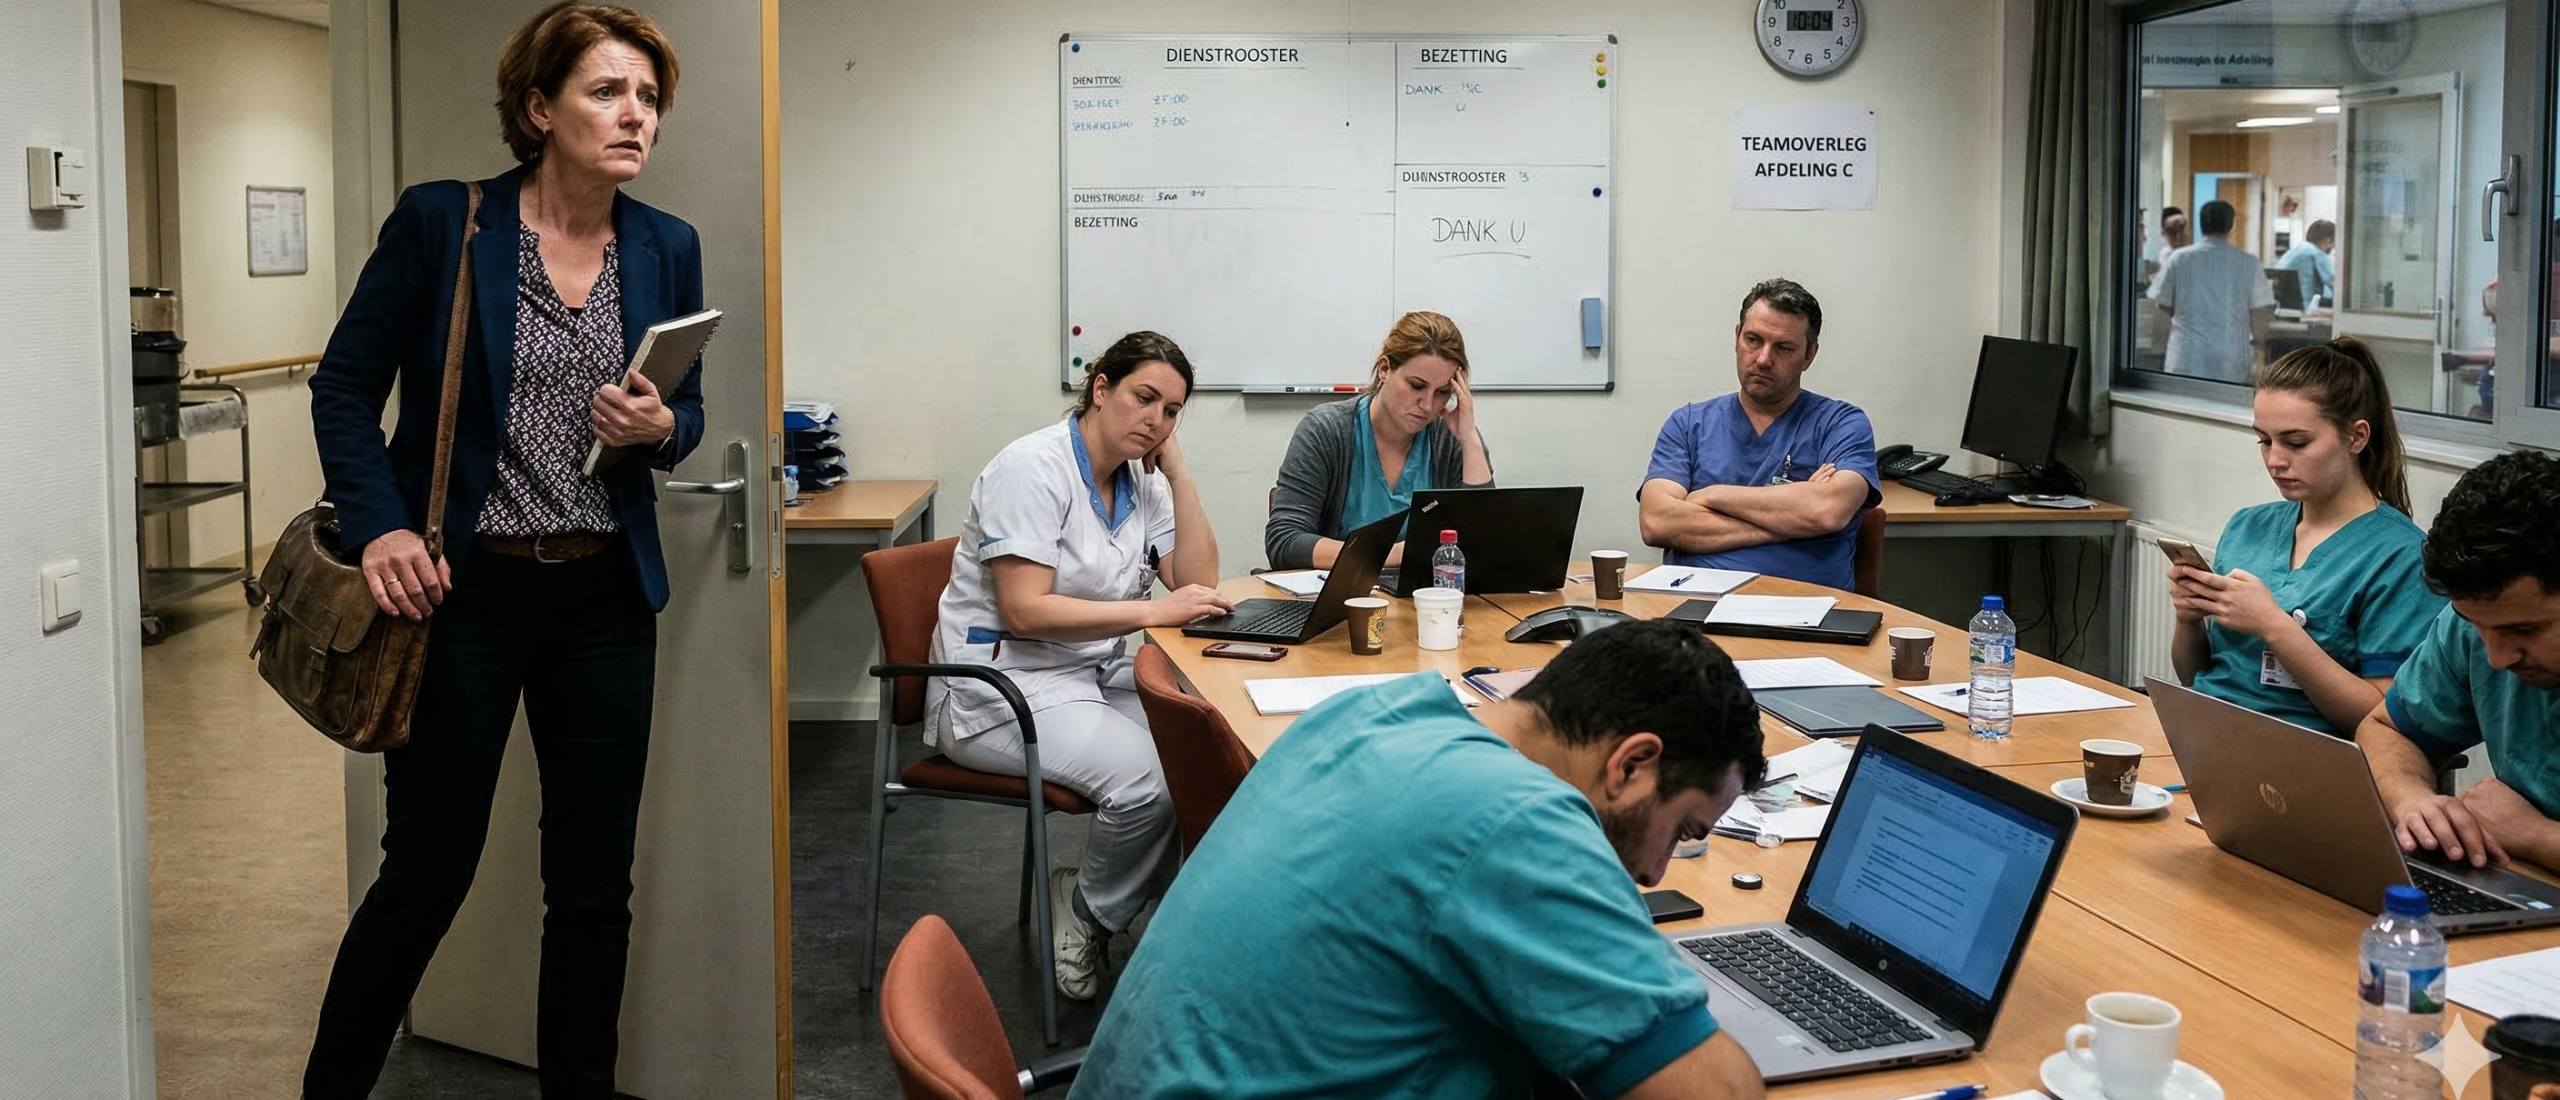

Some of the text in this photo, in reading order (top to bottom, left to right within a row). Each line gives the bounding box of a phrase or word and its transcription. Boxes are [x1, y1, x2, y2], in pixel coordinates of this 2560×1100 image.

[1773, 0, 1786, 10] 10
[1837, 0, 1845, 9] 2
[1768, 17, 1776, 28] 9
[1793, 11, 1833, 30] 10:04
[1842, 17, 1850, 27] 3
[1773, 36, 1782, 47] 8
[1836, 36, 1844, 46] 4
[1166, 48, 1299, 62] DIENSTROOSTER
[1421, 49, 1507, 63] BEZETTING
[1788, 49, 1795, 60] 7
[1804, 53, 1813, 64] 6
[1823, 49, 1831, 60] 5
[1405, 84, 1442, 95] DANK
[1742, 137, 1867, 152] TEAMOVERLEG
[1755, 163, 1853, 177] AFDELING C
[1074, 217, 1138, 228] BEZETTING
[1432, 217, 1526, 243] DANK U
